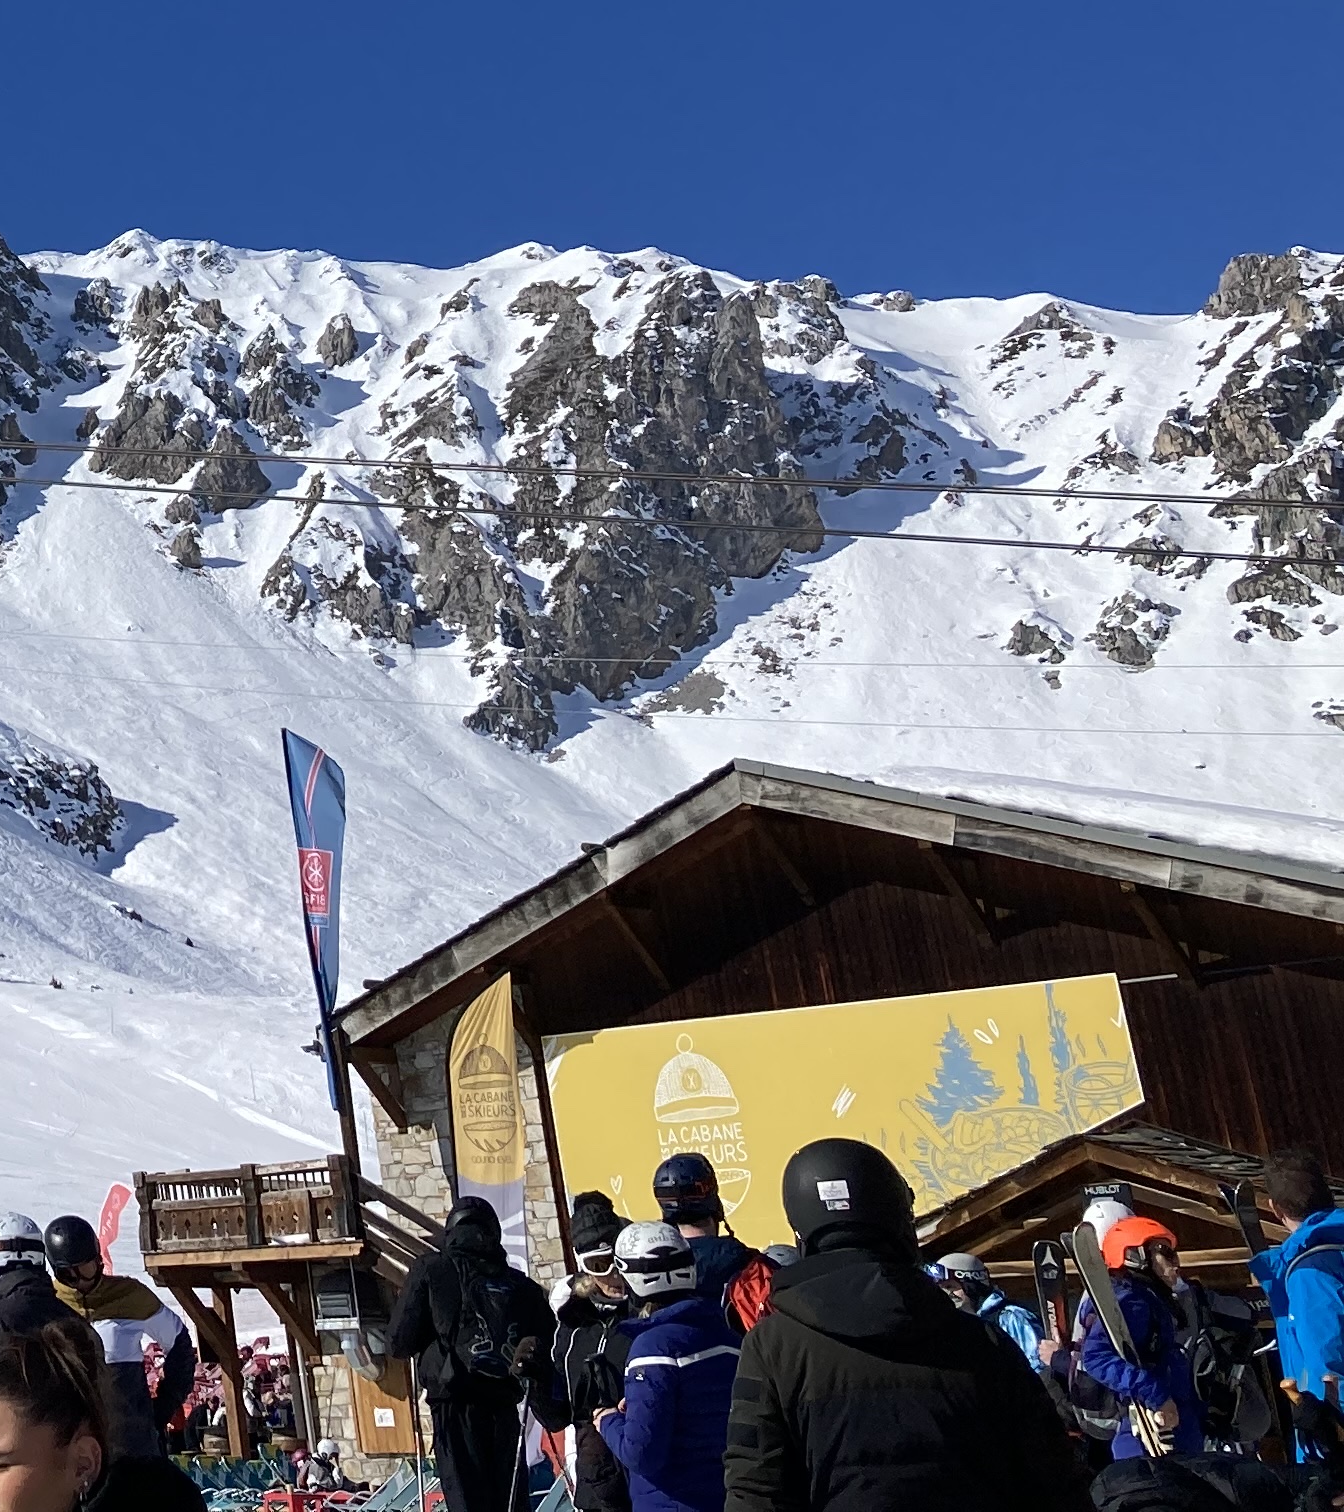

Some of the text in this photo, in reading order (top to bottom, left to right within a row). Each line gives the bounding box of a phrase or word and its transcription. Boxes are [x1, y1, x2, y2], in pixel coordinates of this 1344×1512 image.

[459, 1093, 473, 1104] LA
[468, 1103, 516, 1117] SKIEURS
[657, 1122, 744, 1146] LA CABANE
[1084, 1185, 1120, 1196] HUBLOT
